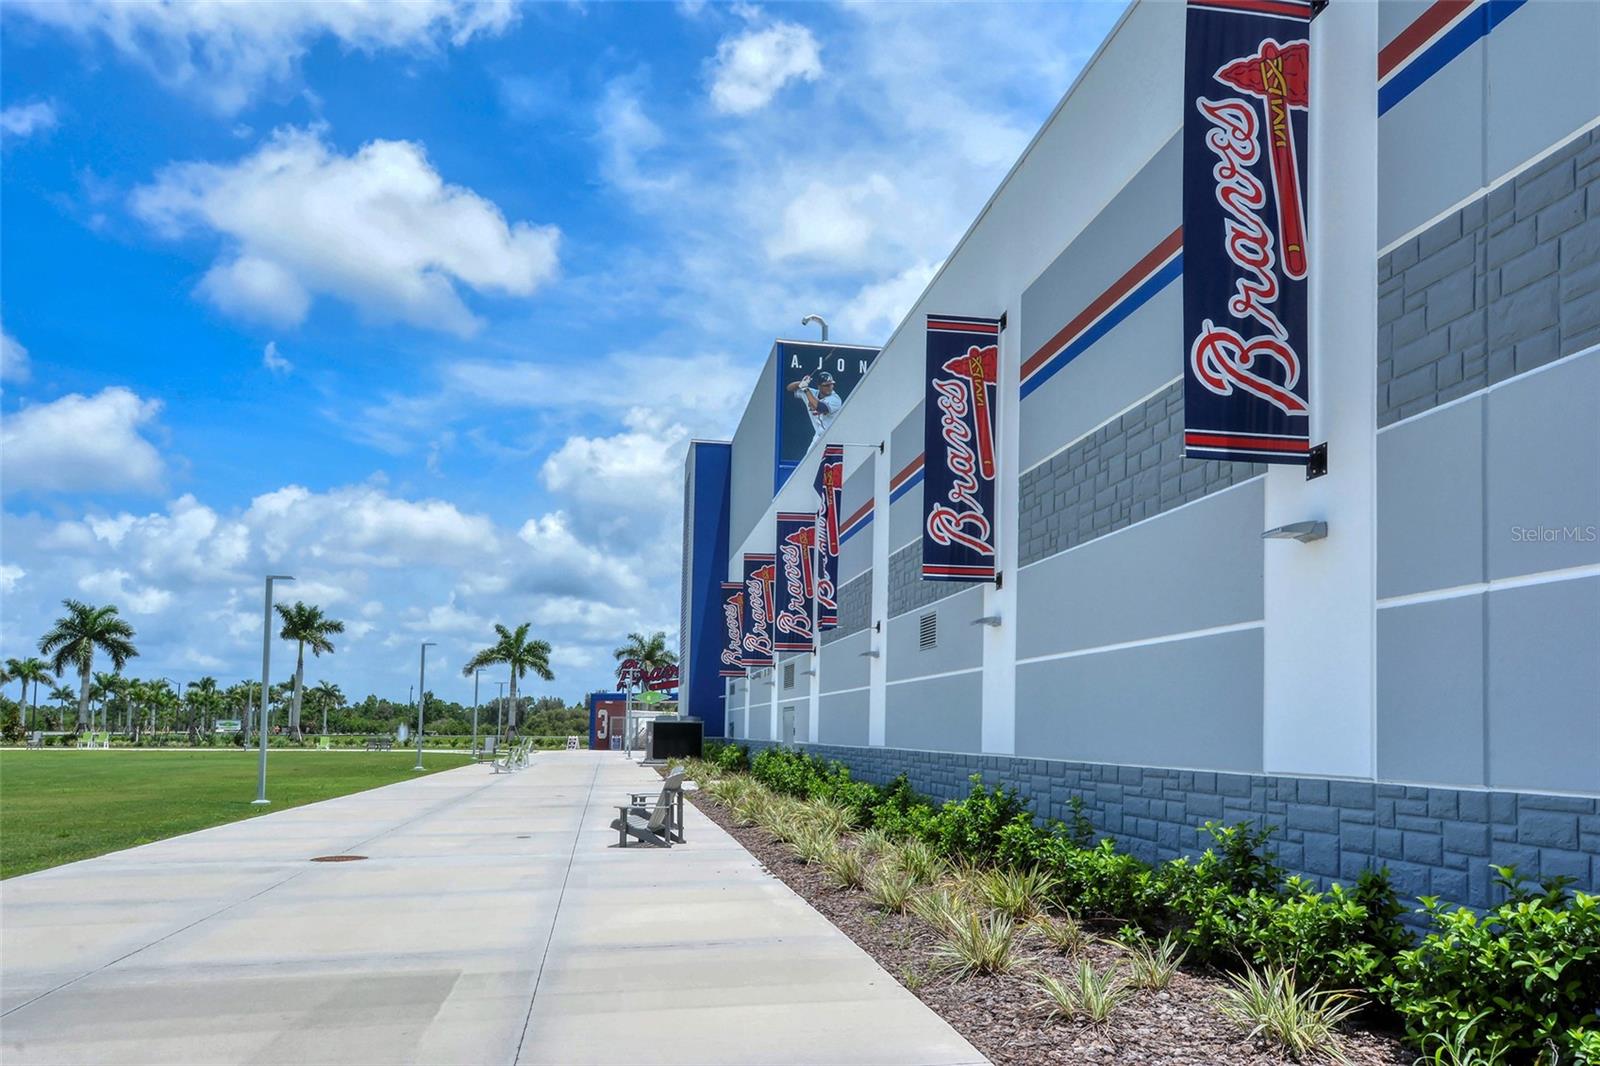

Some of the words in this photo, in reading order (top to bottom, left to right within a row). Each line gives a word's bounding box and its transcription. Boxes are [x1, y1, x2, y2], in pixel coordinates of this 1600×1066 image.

[1191, 96, 1310, 416] Braves
[791, 354, 802, 369] A.
[817, 356, 868, 374] JON
[926, 378, 994, 556] Braves
[743, 580, 773, 656] Braves
[776, 544, 813, 639] Braves
[721, 604, 743, 668] Braves
[597, 709, 609, 740] 3
